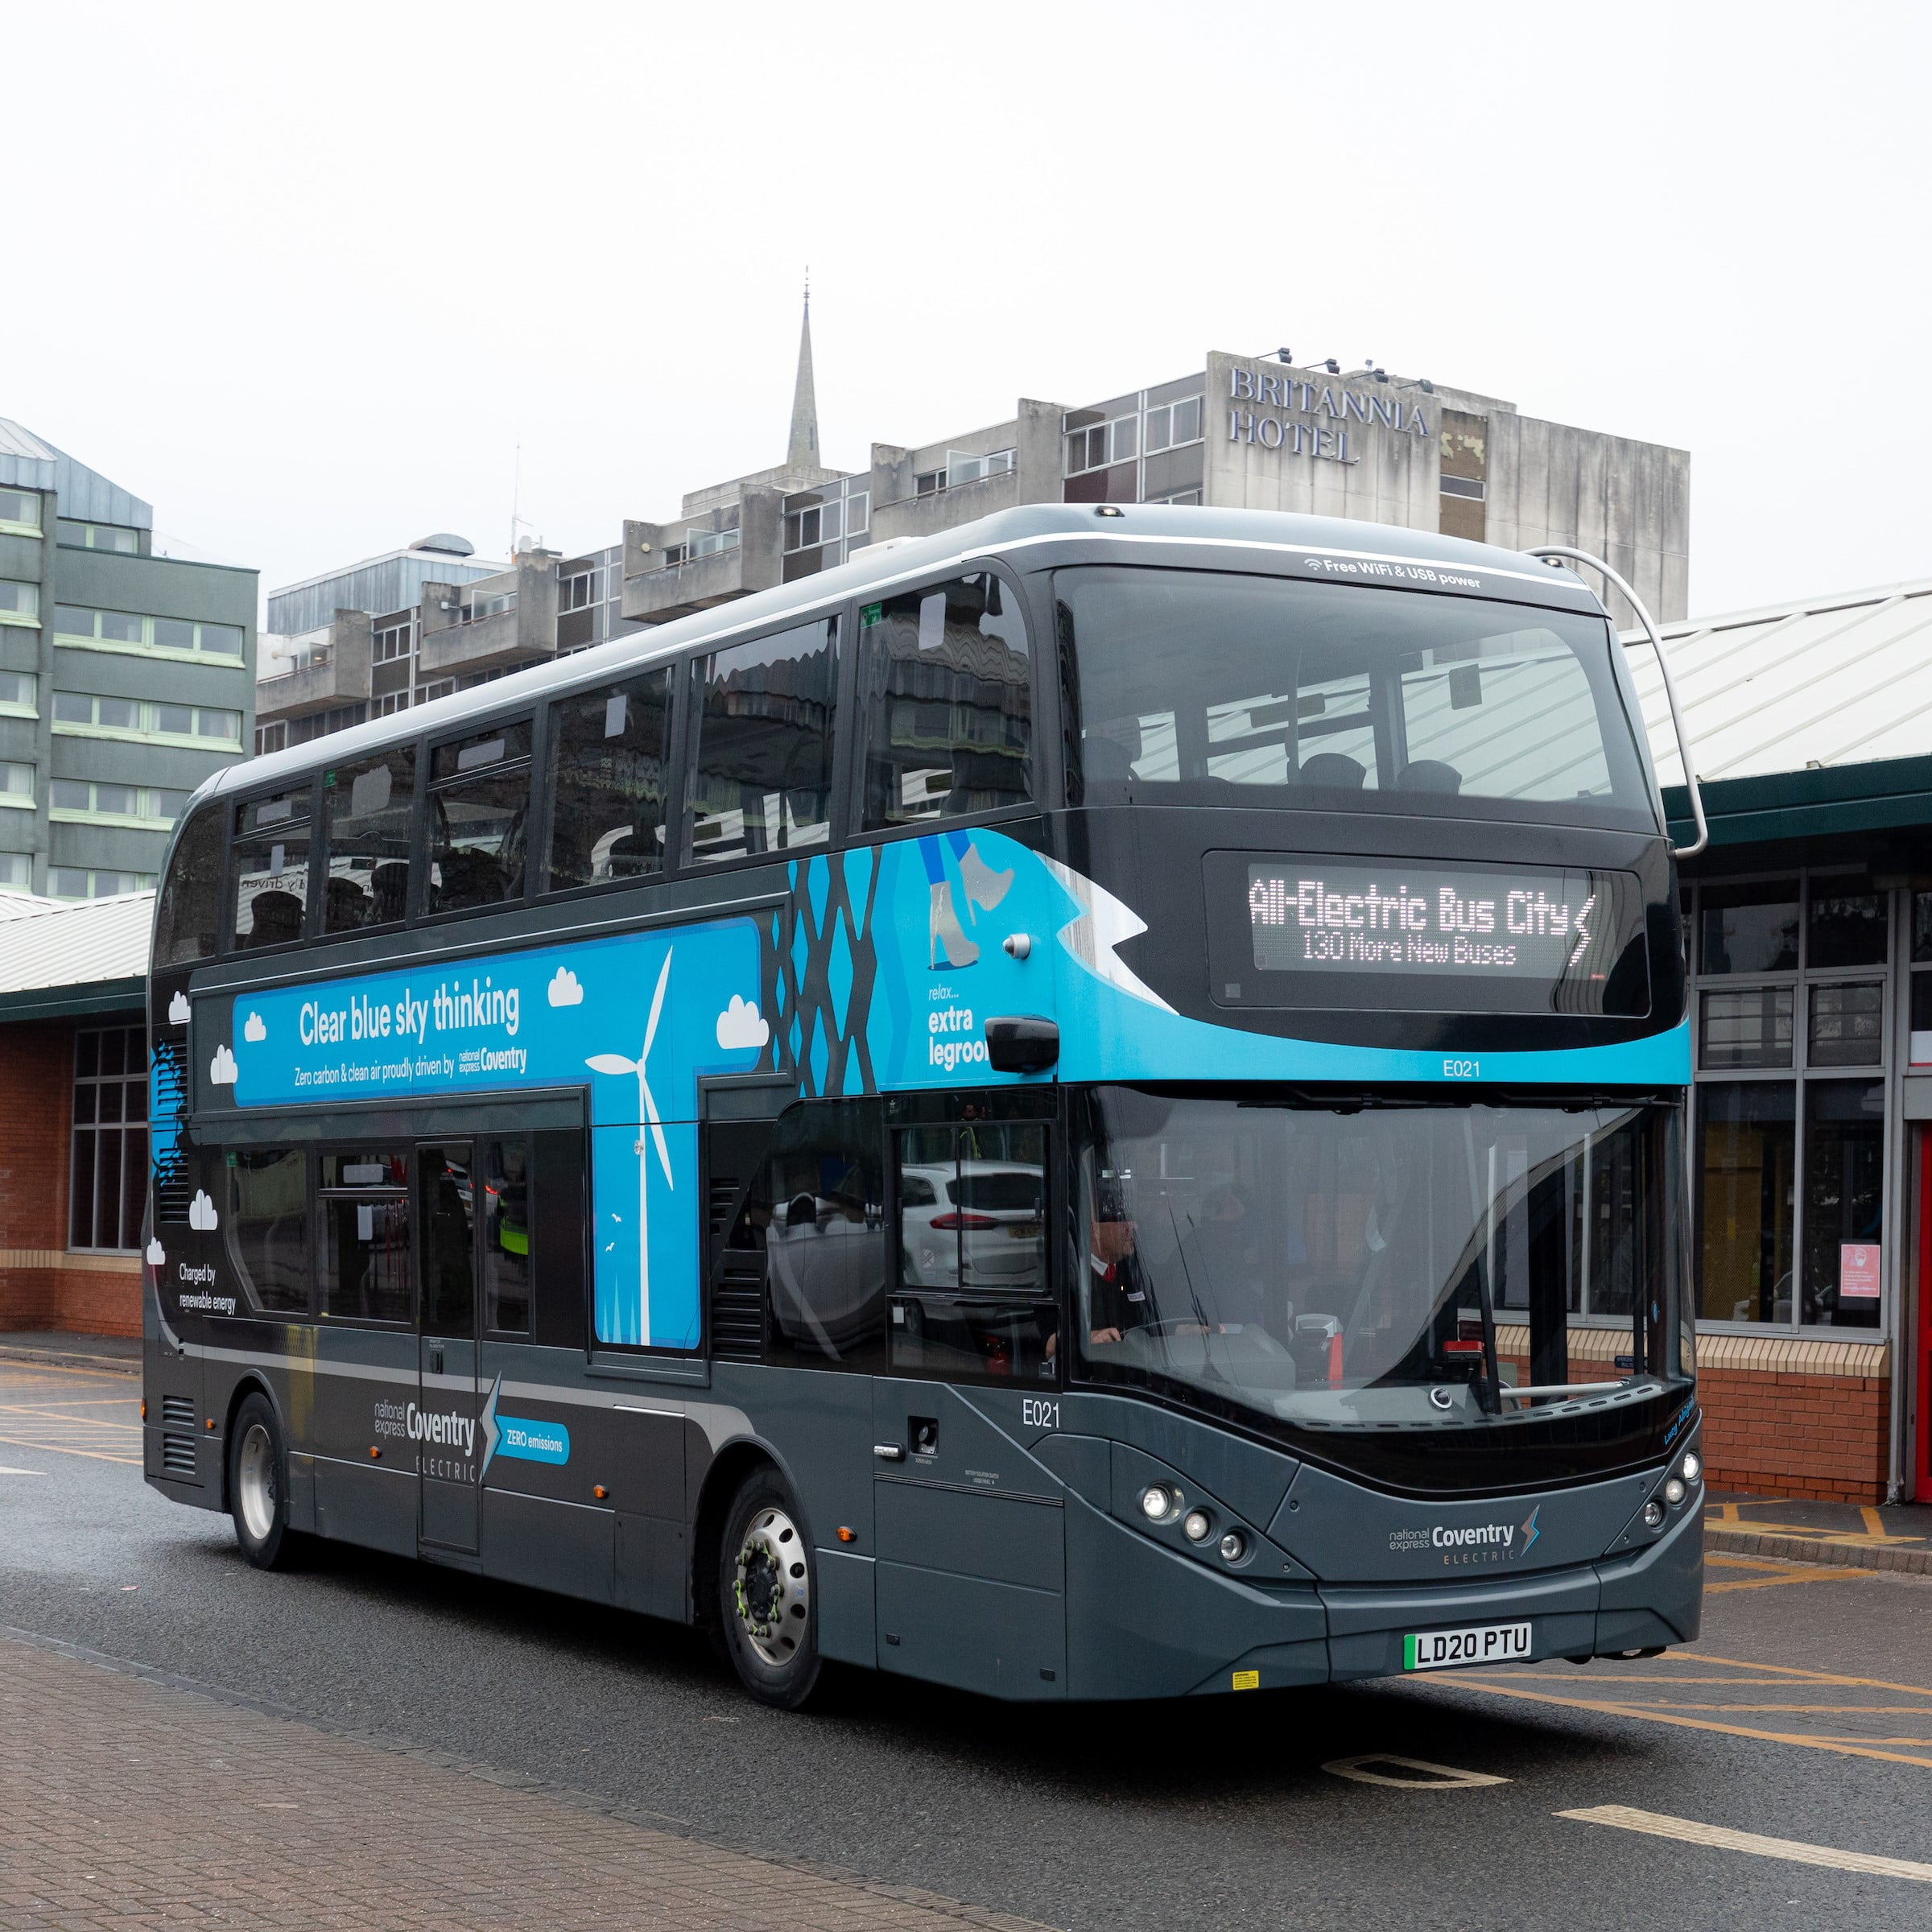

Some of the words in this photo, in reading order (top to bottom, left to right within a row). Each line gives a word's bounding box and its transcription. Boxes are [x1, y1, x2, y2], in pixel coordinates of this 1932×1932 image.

[1230, 367, 1429, 437] BRITANNIA
[1229, 411, 1360, 464] HOTEL
[1323, 559, 1358, 573] Free
[1358, 561, 1393, 576] WiFi
[1394, 565, 1406, 577] &
[1407, 567, 1437, 581] USB
[1439, 573, 1480, 588] power
[1249, 878, 1426, 931] All-Electric
[1439, 887, 1495, 932] Bus
[1507, 891, 1568, 935] City
[1304, 930, 1344, 960] 130
[1350, 932, 1402, 961] More
[1408, 934, 1449, 963] New
[1455, 935, 1517, 965] Buses
[928, 983, 960, 1001] relax...
[299, 1001, 348, 1046] Clear
[350, 995, 390, 1041] blue
[395, 988, 429, 1045] sky
[432, 976, 519, 1036] thinking
[928, 1005, 973, 1034] extra
[459, 1048, 481, 1063] national
[459, 1062, 481, 1075] express
[481, 1046, 527, 1074] Coventry
[1443, 1059, 1480, 1078] E021
[295, 1067, 312, 1087] Zero
[313, 1064, 340, 1084] carbon
[341, 1063, 349, 1082] &
[348, 1062, 369, 1082] clean
[370, 1059, 382, 1080] air
[382, 1057, 414, 1084] proudly
[415, 1055, 442, 1077] driven
[444, 1053, 455, 1079] by
[179, 1262, 206, 1286] Charged
[207, 1263, 216, 1286] by
[179, 1290, 212, 1309] renewable
[213, 1296, 236, 1315] energy
[374, 1399, 405, 1421] national
[1022, 1398, 1060, 1429] E021
[374, 1419, 405, 1439] express
[407, 1402, 475, 1457] Coventry
[506, 1429, 527, 1447] ZERO
[527, 1434, 563, 1453] emissions
[415, 1455, 475, 1483] ELECTRIC
[1389, 1527, 1430, 1541] national
[1389, 1538, 1430, 1552] express
[1432, 1524, 1514, 1547] Coventry
[1443, 1550, 1514, 1565] ELECTRIC
[1418, 1633, 1477, 1663] LD20
[1484, 1627, 1528, 1656] PTU
